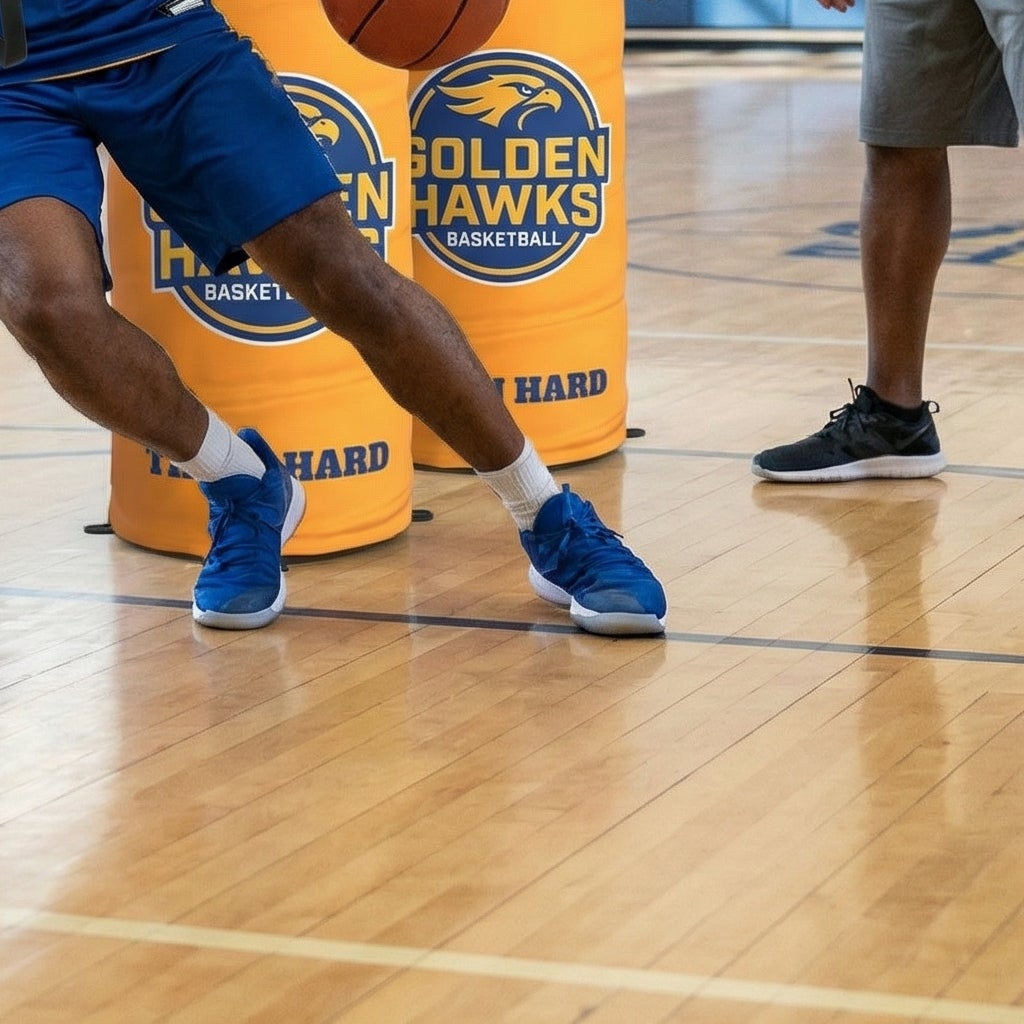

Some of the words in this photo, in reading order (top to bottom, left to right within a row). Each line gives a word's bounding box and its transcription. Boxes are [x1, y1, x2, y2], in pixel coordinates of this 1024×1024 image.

[411, 183, 598, 227] HAWKS
[447, 231, 562, 247] BASKETBALL
[205, 283, 295, 301] BASKET
[514, 368, 607, 404] HARD
[283, 441, 389, 481] HARD
